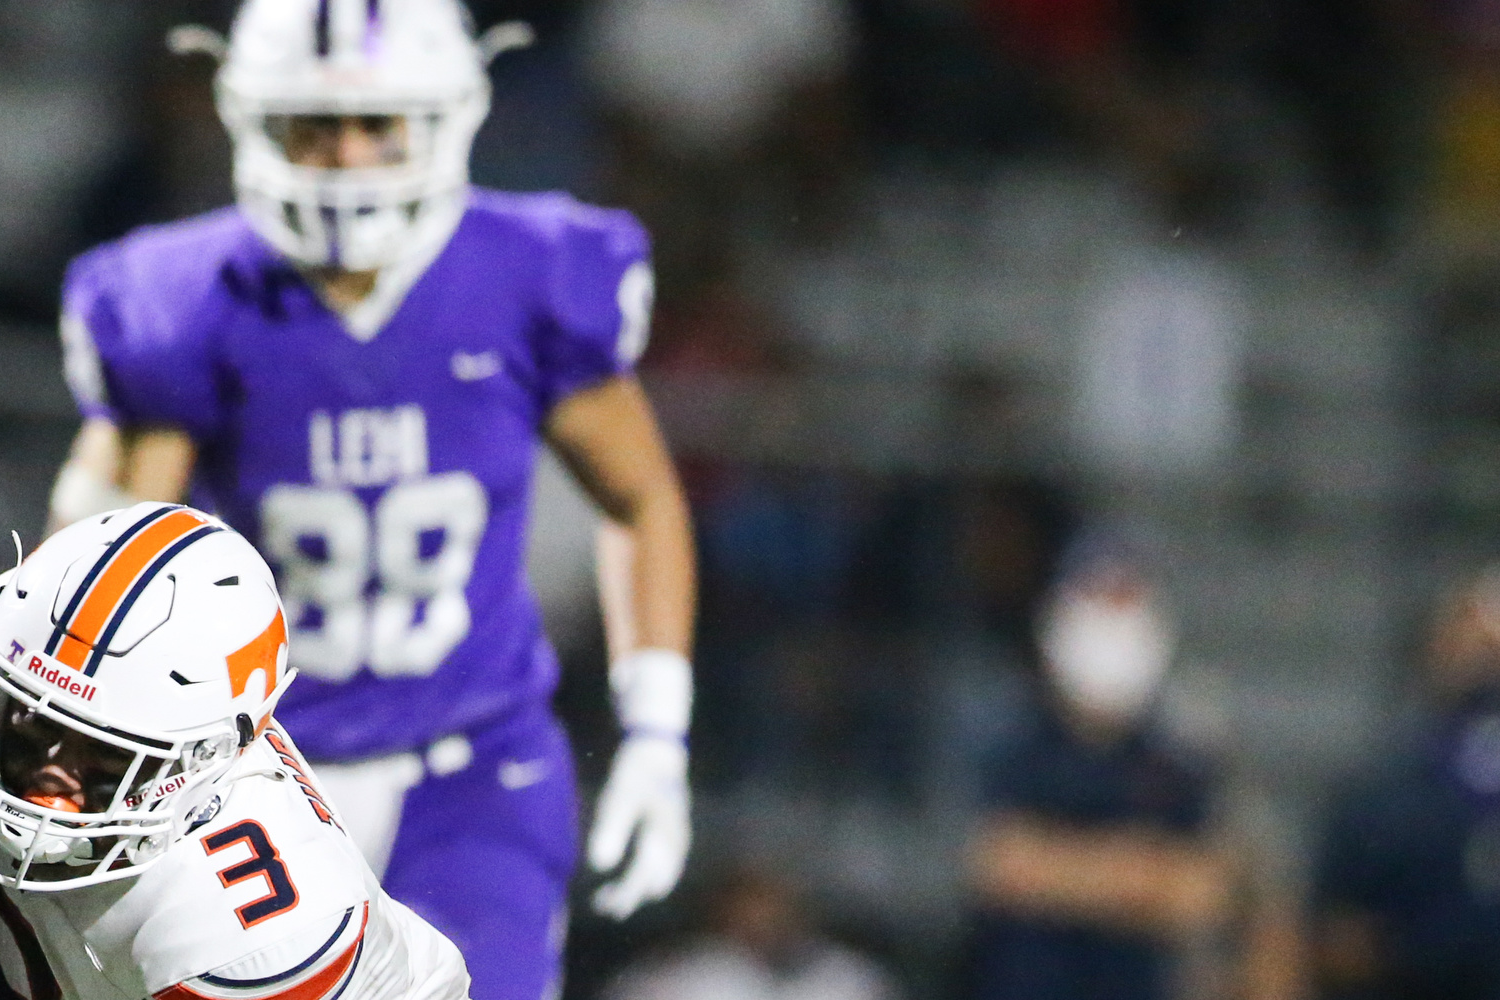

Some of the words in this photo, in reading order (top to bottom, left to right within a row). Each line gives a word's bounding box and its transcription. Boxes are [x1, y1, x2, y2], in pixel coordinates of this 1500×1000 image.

[260, 468, 490, 684] 88
[6, 638, 26, 663] T
[27, 655, 97, 702] Riddell
[199, 818, 300, 931] 3
